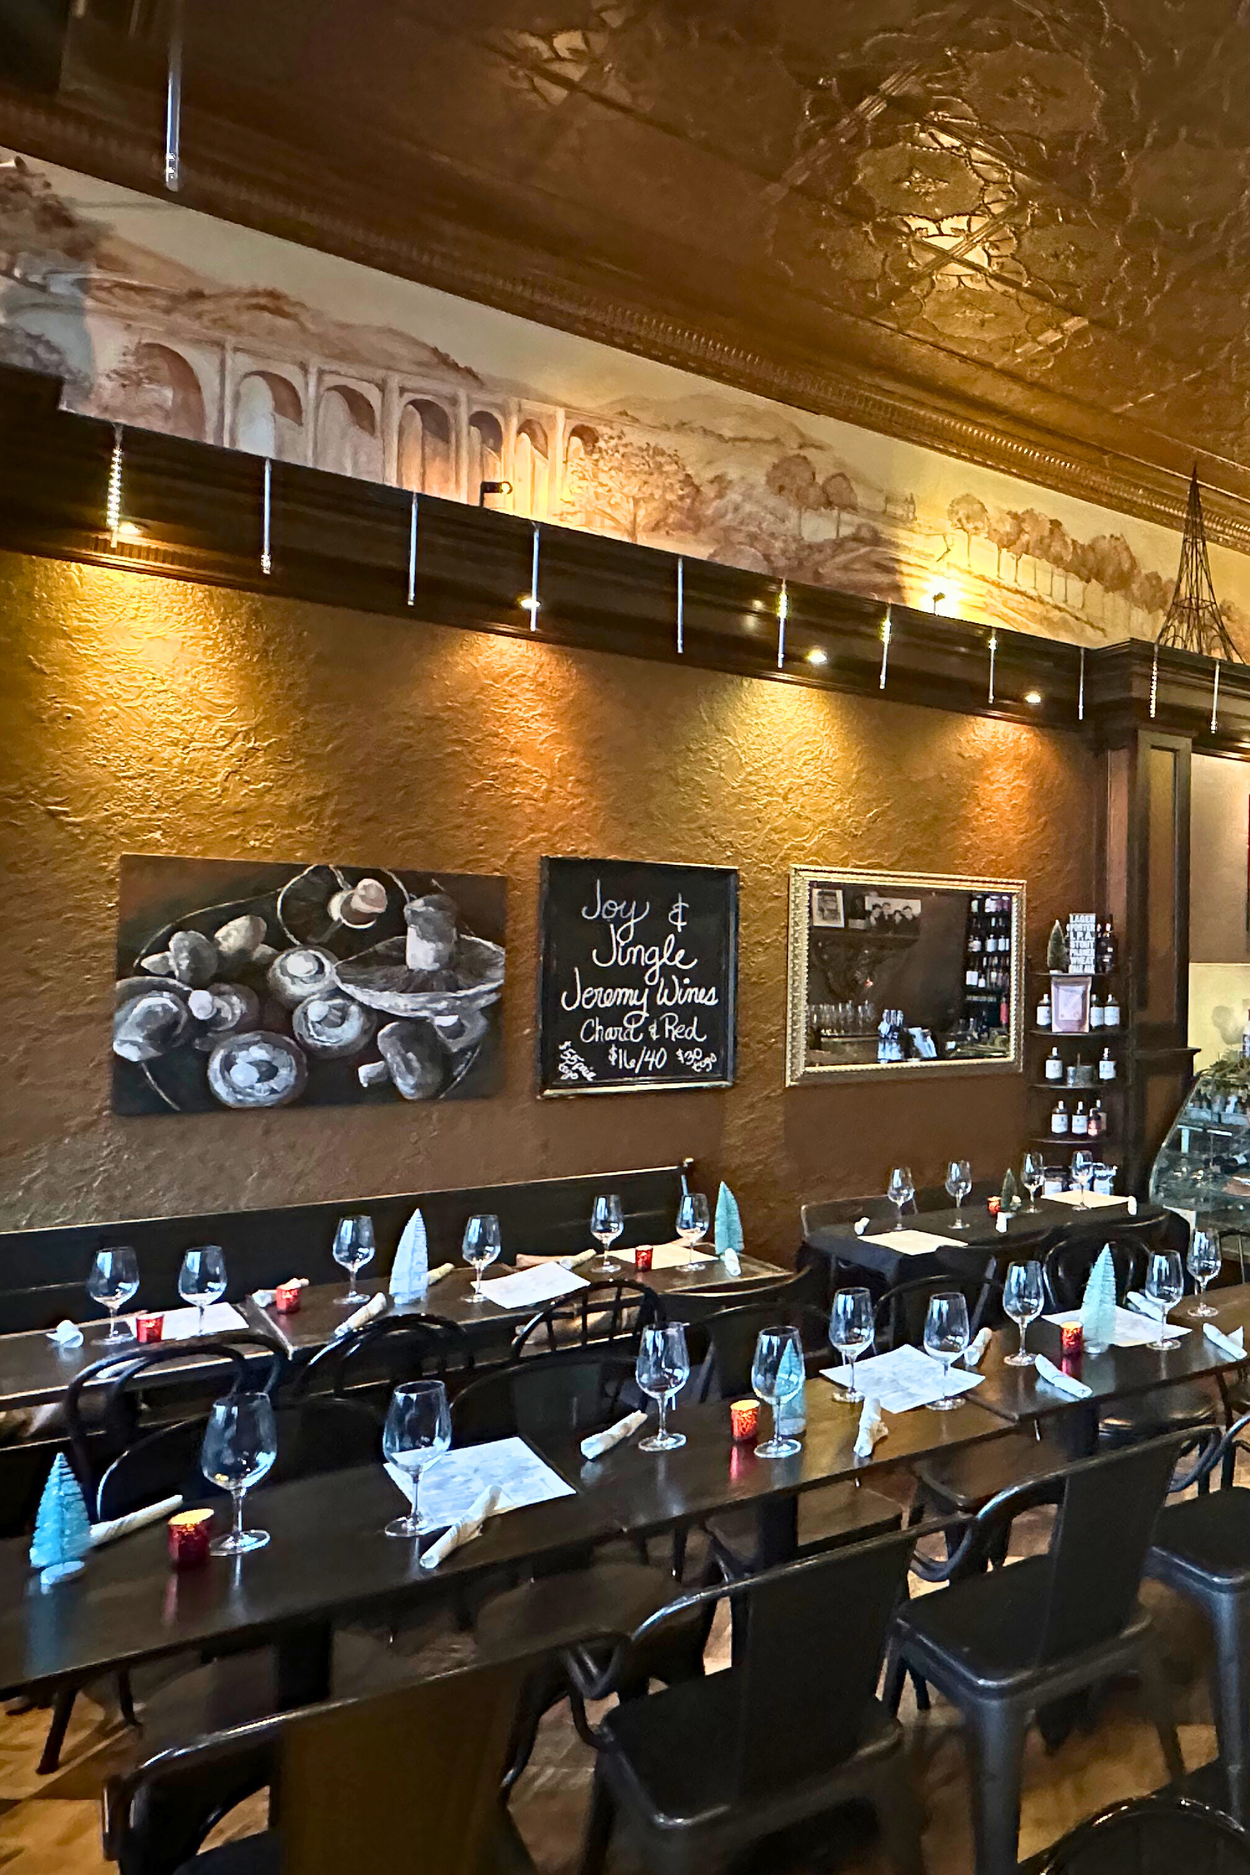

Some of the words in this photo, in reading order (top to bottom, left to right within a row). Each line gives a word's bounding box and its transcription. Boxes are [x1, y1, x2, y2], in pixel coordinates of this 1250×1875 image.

[581, 878, 651, 943] Joy
[592, 923, 698, 985] Jingle
[560, 967, 650, 1026] Jeremy
[656, 975, 719, 1006] Wines
[580, 1016, 645, 1043] Chard
[659, 1012, 708, 1042] Red
[608, 1043, 668, 1074] $16/40
